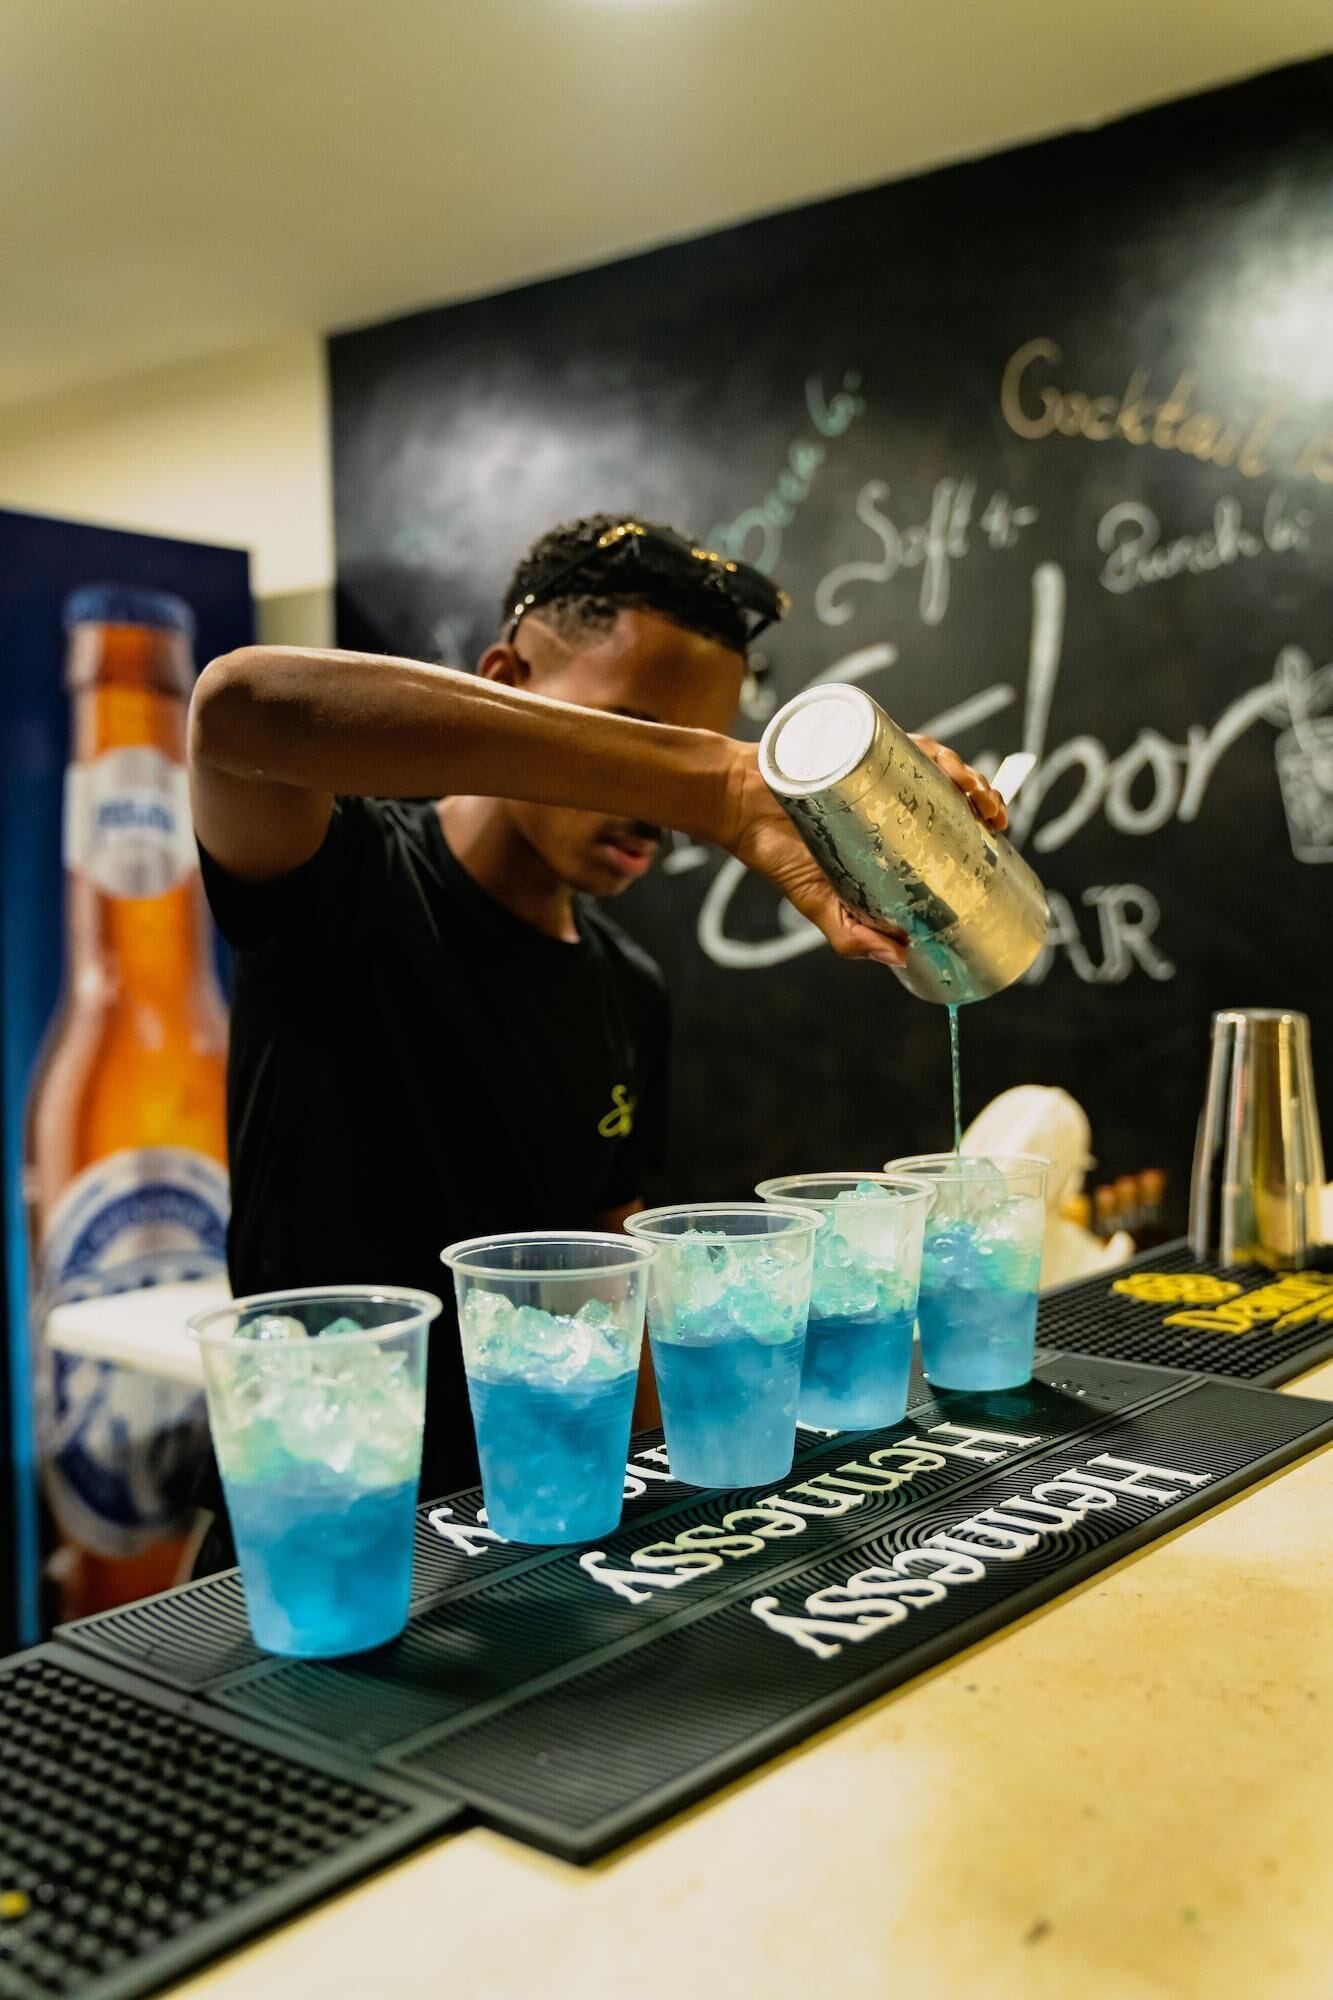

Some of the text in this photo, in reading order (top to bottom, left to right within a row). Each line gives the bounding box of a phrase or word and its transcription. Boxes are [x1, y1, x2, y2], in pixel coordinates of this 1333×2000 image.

[1000, 337, 1288, 478] Cocktail
[815, 476, 978, 626] Soft
[579, 1421, 1041, 1604] Hennessy
[751, 1451, 1213, 1660] Hennessy
